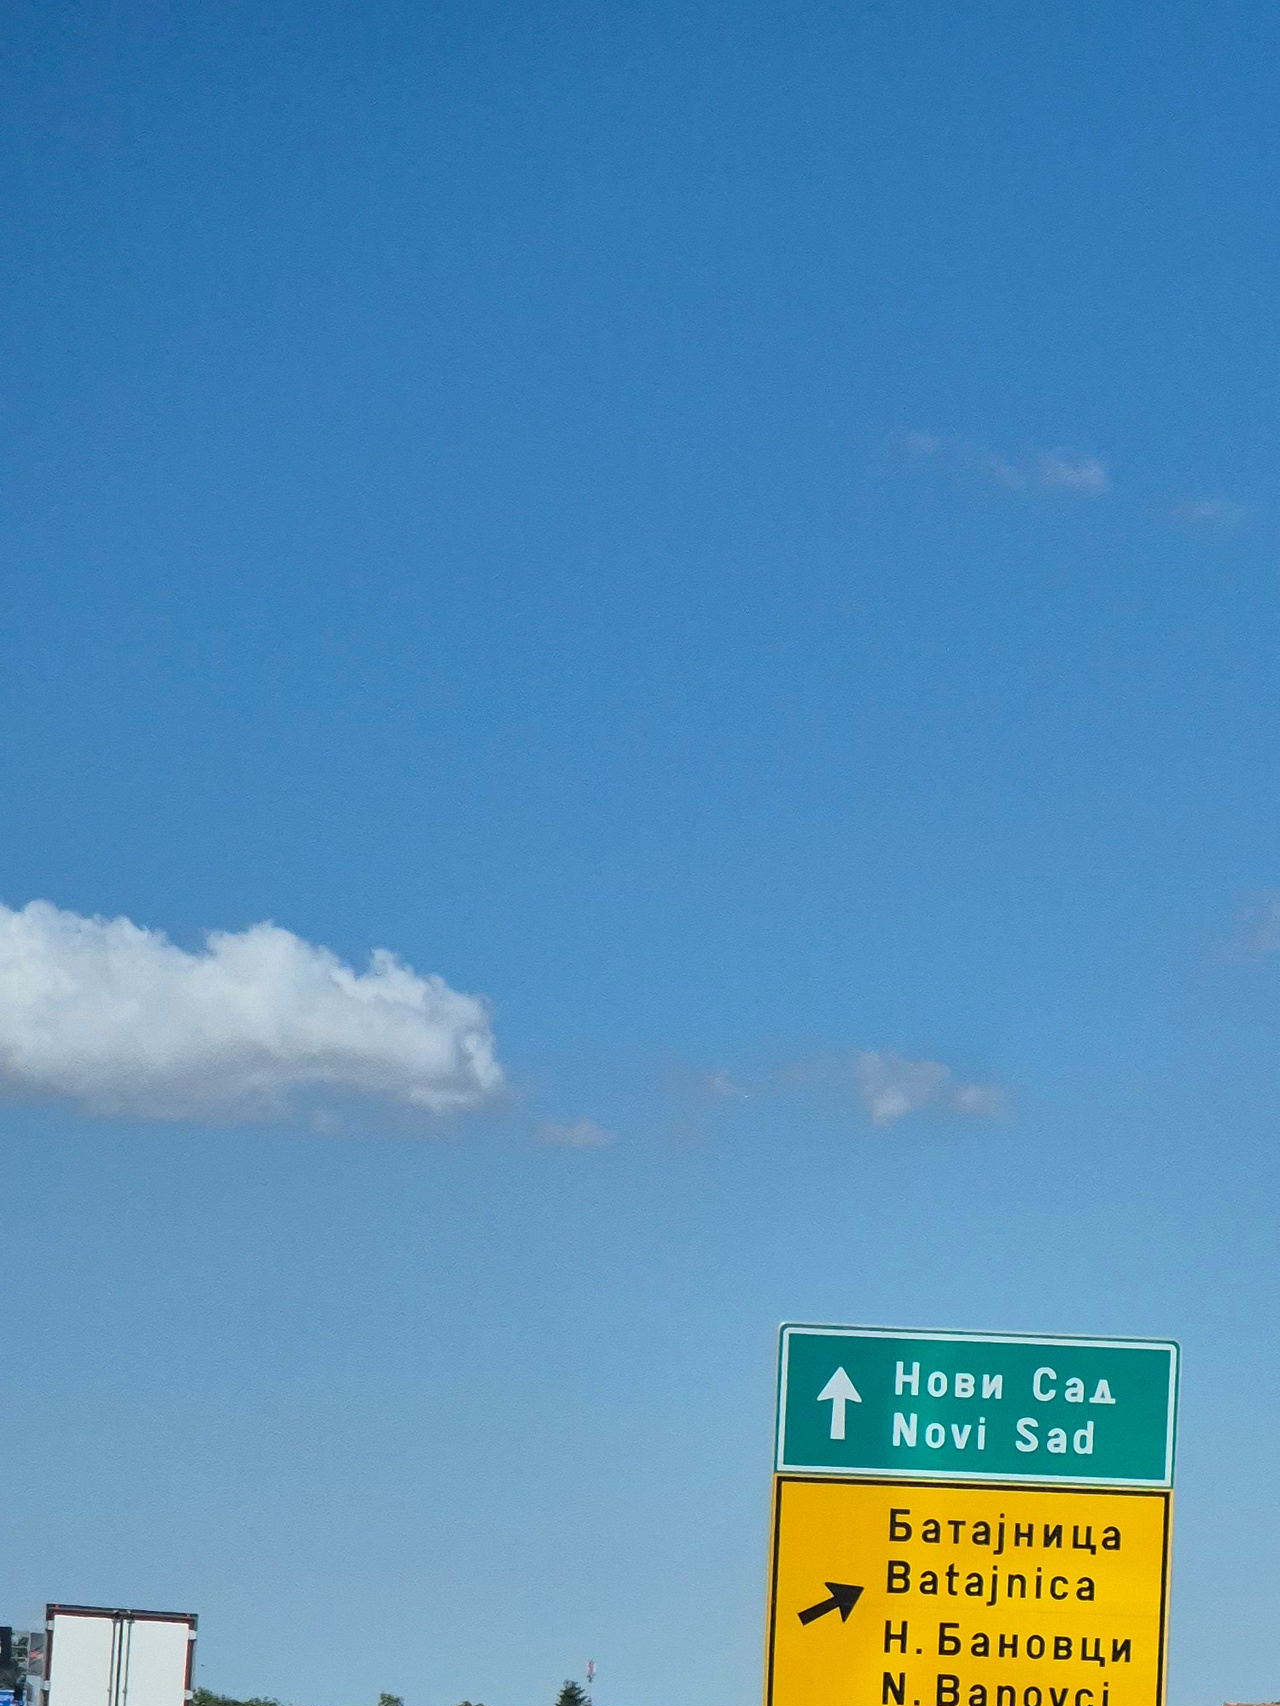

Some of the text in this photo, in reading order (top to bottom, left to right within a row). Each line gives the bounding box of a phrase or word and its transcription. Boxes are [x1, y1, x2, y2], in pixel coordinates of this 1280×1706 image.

[895, 1361, 1116, 1405] Нови Сад
[892, 1412, 1094, 1455] Novi Sad
[889, 1508, 1121, 1556] Батајница
[886, 1560, 1095, 1607] Batajnica
